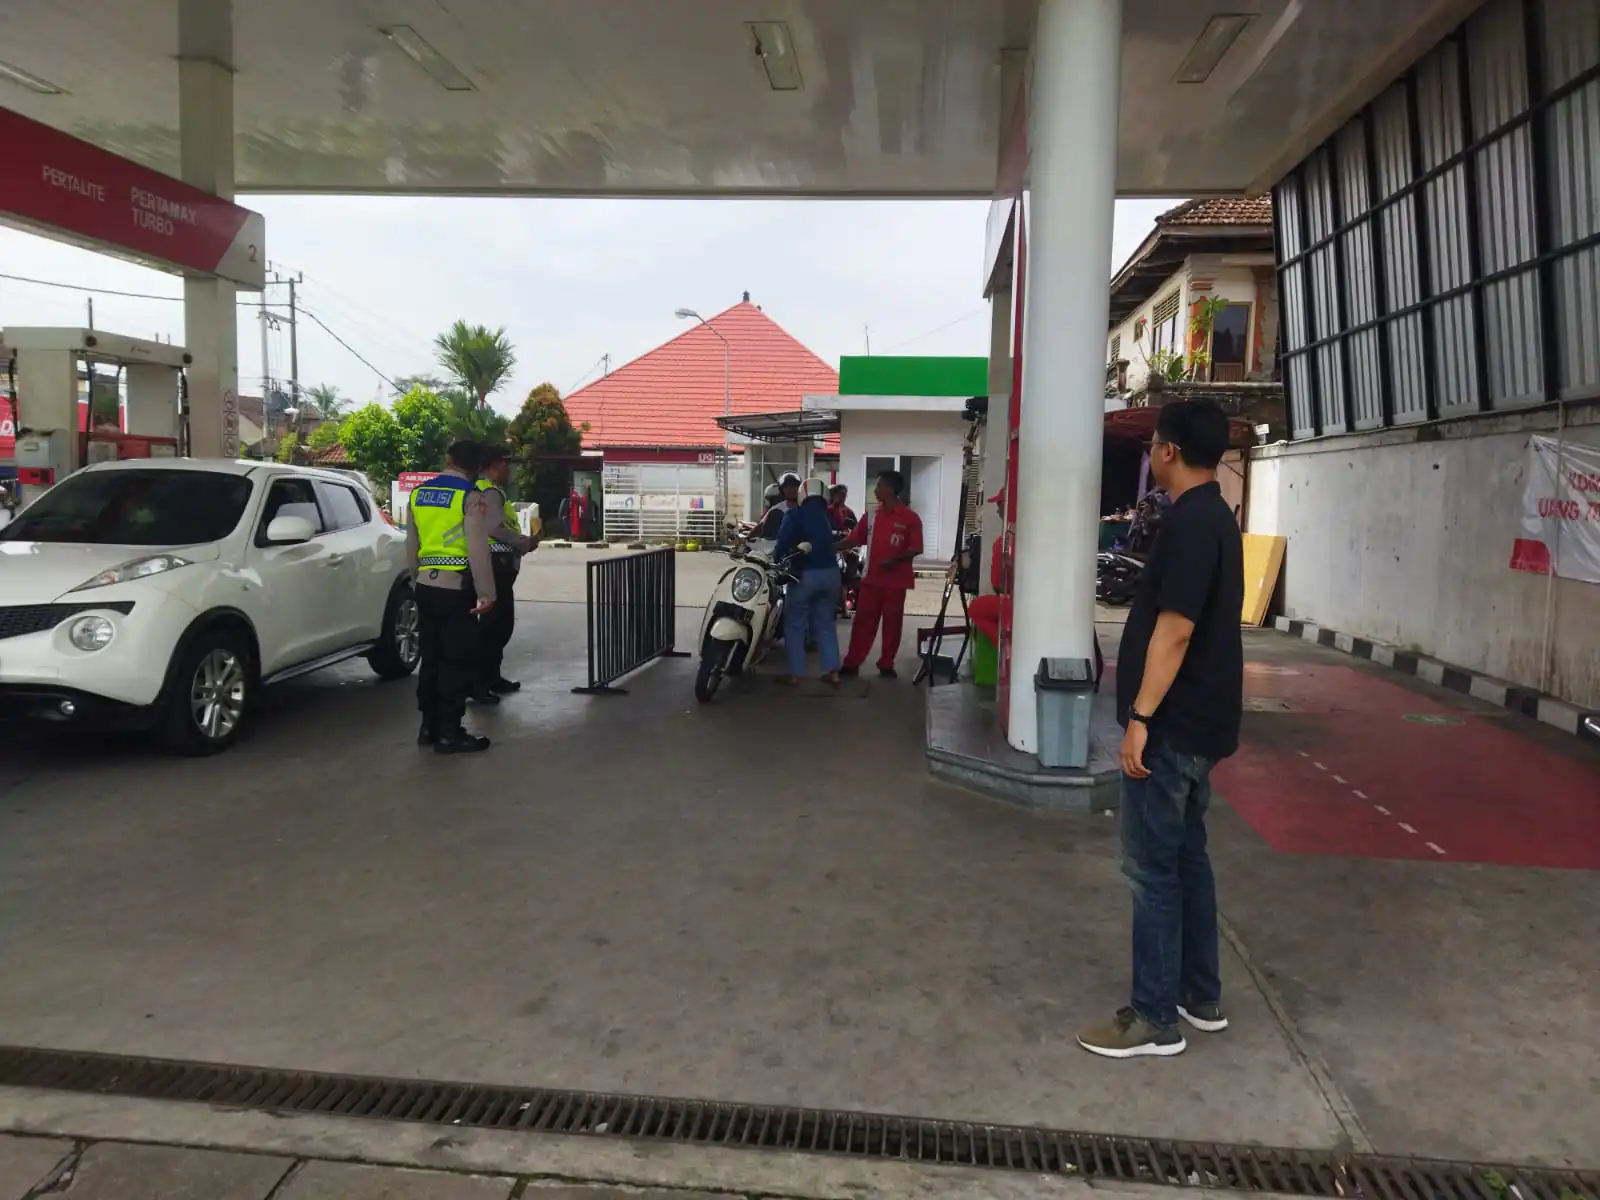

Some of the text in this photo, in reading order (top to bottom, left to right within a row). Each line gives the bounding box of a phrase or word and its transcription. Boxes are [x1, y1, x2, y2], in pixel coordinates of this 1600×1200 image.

[42, 165, 105, 203] PERTALITE
[130, 187, 198, 226] PERTAMAX
[131, 208, 175, 236] TURBO
[247, 244, 258, 263] 2
[416, 490, 452, 505] POLISI
